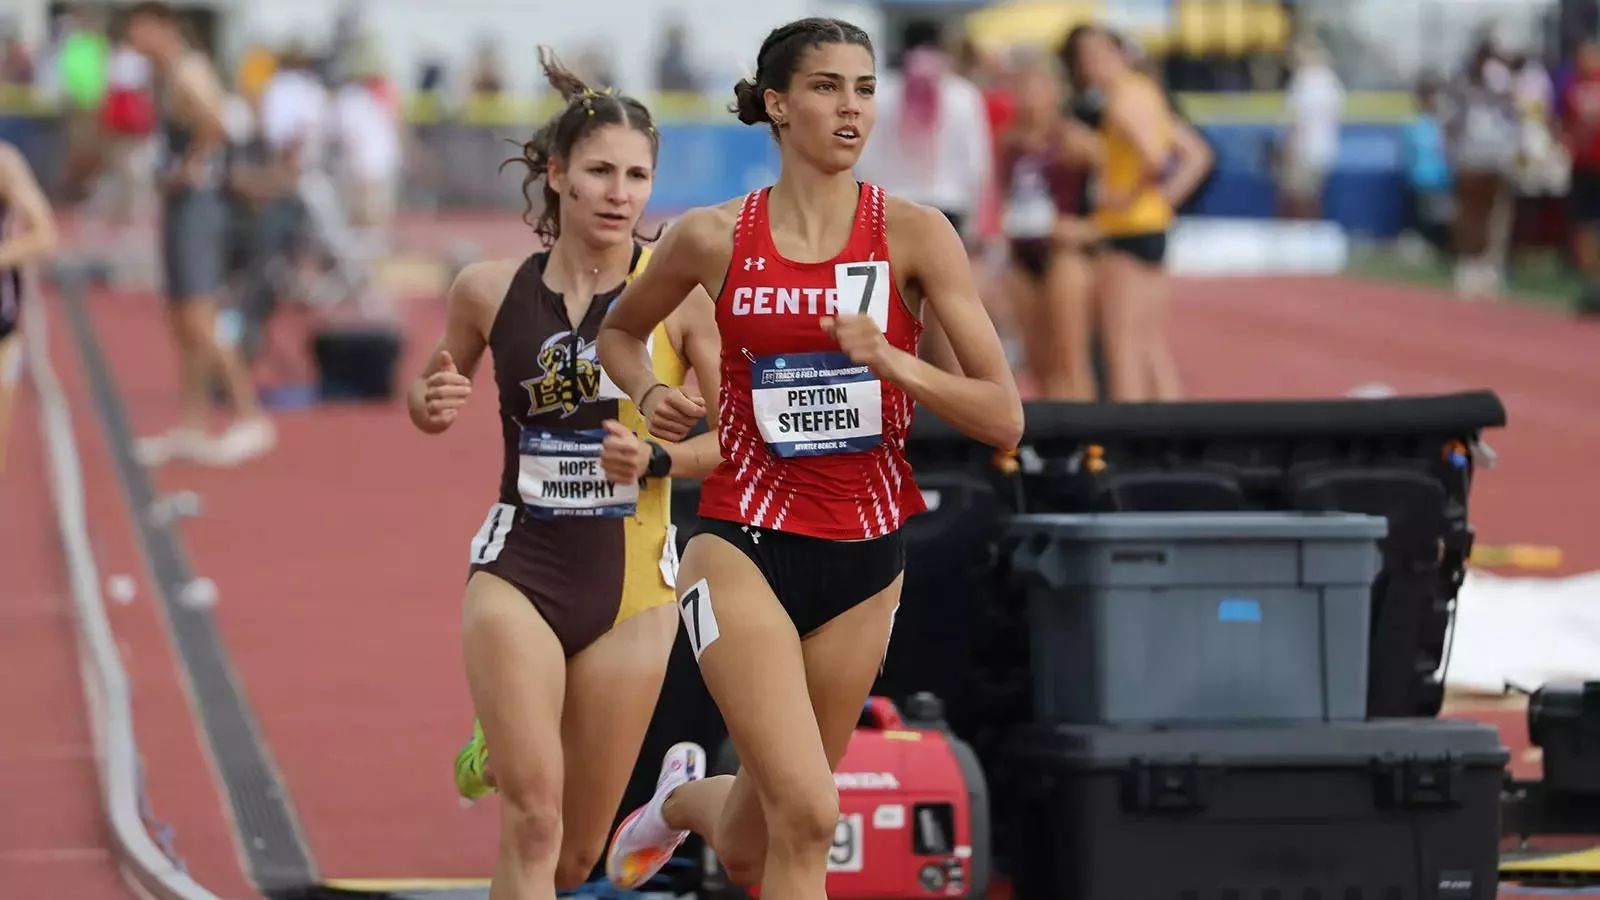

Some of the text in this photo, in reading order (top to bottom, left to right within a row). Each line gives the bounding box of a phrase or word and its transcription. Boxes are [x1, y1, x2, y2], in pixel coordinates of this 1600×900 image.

[847, 266, 877, 316] 7
[775, 371, 795, 379] TRACK
[801, 369, 818, 378] FIELD
[819, 366, 869, 377] CHAMPIONSHIPS
[788, 387, 848, 407] PEYTON
[778, 408, 860, 433] STEFFEN
[559, 460, 597, 476] HOPE
[541, 481, 616, 499] MURPHY
[681, 588, 702, 651] 7
